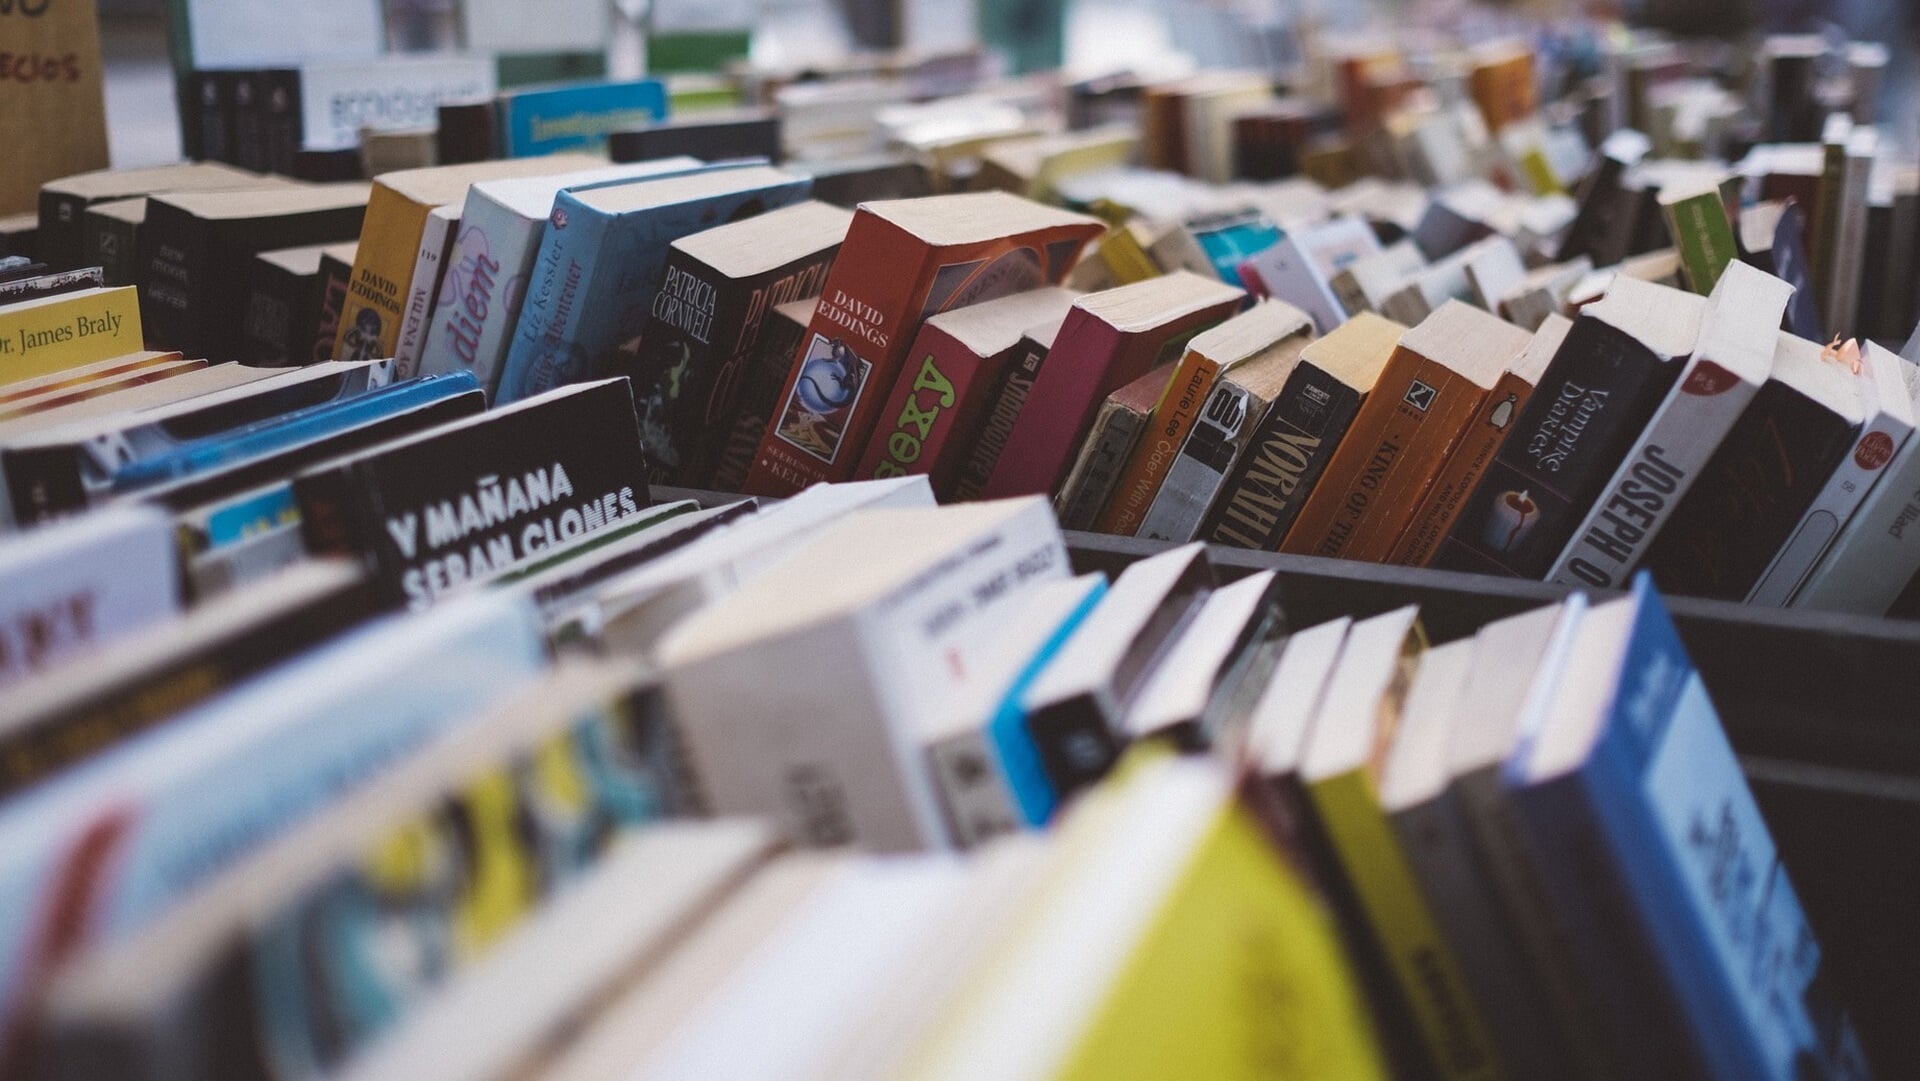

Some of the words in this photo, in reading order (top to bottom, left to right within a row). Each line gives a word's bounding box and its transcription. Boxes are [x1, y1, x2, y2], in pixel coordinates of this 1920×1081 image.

[351, 280, 401, 314] EDDINGS
[361, 268, 398, 296] DAVID
[533, 240, 562, 311] Kessler
[662, 265, 718, 315] PATRICIA
[446, 253, 500, 364] diem
[523, 314, 544, 344] Liz
[652, 291, 714, 345] CORNWELL
[817, 301, 890, 349] EDDINGS
[833, 289, 885, 328] DAVID
[19, 325, 73, 356] James
[76, 310, 122, 339] Braly
[1180, 366, 1211, 411] Laurie
[1164, 409, 1187, 438] Lee
[1537, 388, 1609, 473] Vampire
[1145, 439, 1176, 478] Cider
[1226, 414, 1323, 537] NORAH
[1361, 439, 1401, 492] KING
[387, 514, 419, 558] Y
[425, 463, 573, 549] MAÑANA
[1344, 491, 1370, 520] OF
[1585, 444, 1685, 564] JOSEPH
